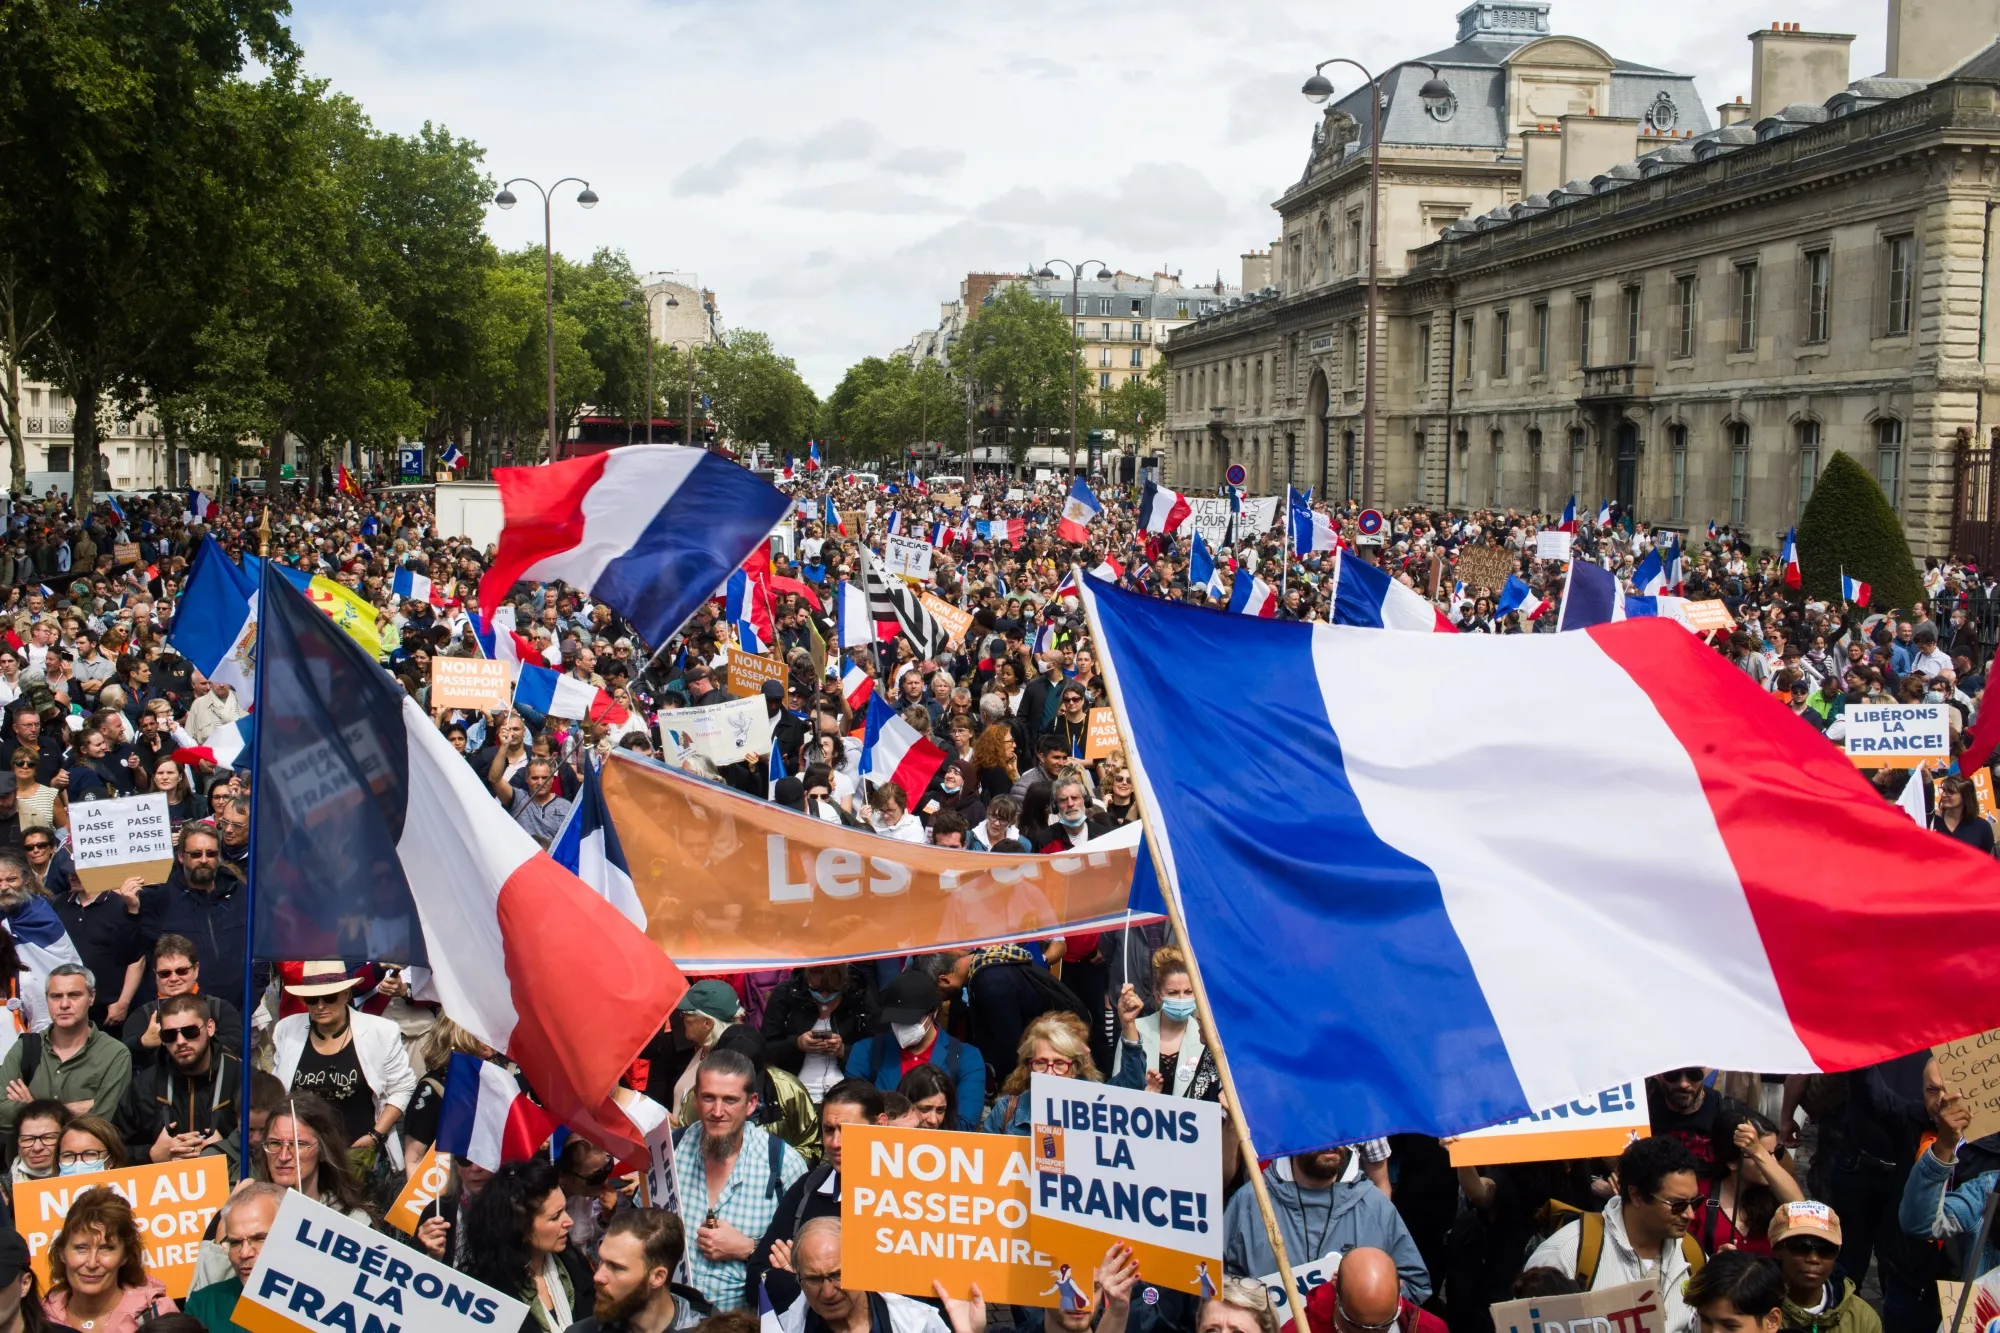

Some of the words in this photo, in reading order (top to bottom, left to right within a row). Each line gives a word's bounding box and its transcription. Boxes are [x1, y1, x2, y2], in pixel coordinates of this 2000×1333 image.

[401, 451, 414, 468] P
[1195, 515, 1227, 527] POUR
[1467, 547, 1489, 558] NON
[1462, 555, 1513, 571] VACCINATION
[1460, 563, 1510, 580] OBLIGATOIRE
[925, 598, 951, 615] NON
[951, 611, 968, 624] AU
[1686, 603, 1706, 611] NON
[441, 661, 478, 674] NON
[481, 663, 503, 676] AU
[734, 654, 762, 671] NON
[764, 664, 782, 676] AU
[436, 675, 505, 688] PASSEPORT
[443, 687, 499, 698] SANITAIRE
[1854, 708, 1939, 723] LIBÉRONS
[1882, 722, 1906, 733] LA
[1850, 735, 1943, 752] FRANCE!
[87, 809, 102, 818] LA
[136, 803, 151, 812] LA
[78, 821, 114, 832] PASSE
[127, 815, 163, 827] PASSE
[80, 834, 116, 846] PASSE
[128, 829, 164, 840] PASSE
[80, 849, 103, 860] PAS
[106, 848, 118, 857] !!!
[129, 844, 151, 854] PAS
[154, 842, 166, 852] !!!
[766, 834, 911, 902] Les
[295, 1070, 326, 1085] PURA
[329, 1069, 358, 1087] VIDA
[1046, 1094, 1199, 1144] LIBÉRONS
[1037, 1125, 1052, 1134] NON
[1053, 1127, 1062, 1136] AU
[1095, 1135, 1136, 1170] LA
[870, 1141, 984, 1185] NON
[150, 1170, 207, 1206] AU
[1039, 1171, 1209, 1234] FRANCE!
[875, 1227, 1052, 1267] SANITAIRE
[295, 1218, 499, 1324] LIBÉRONS
[353, 1272, 404, 1316] LA
